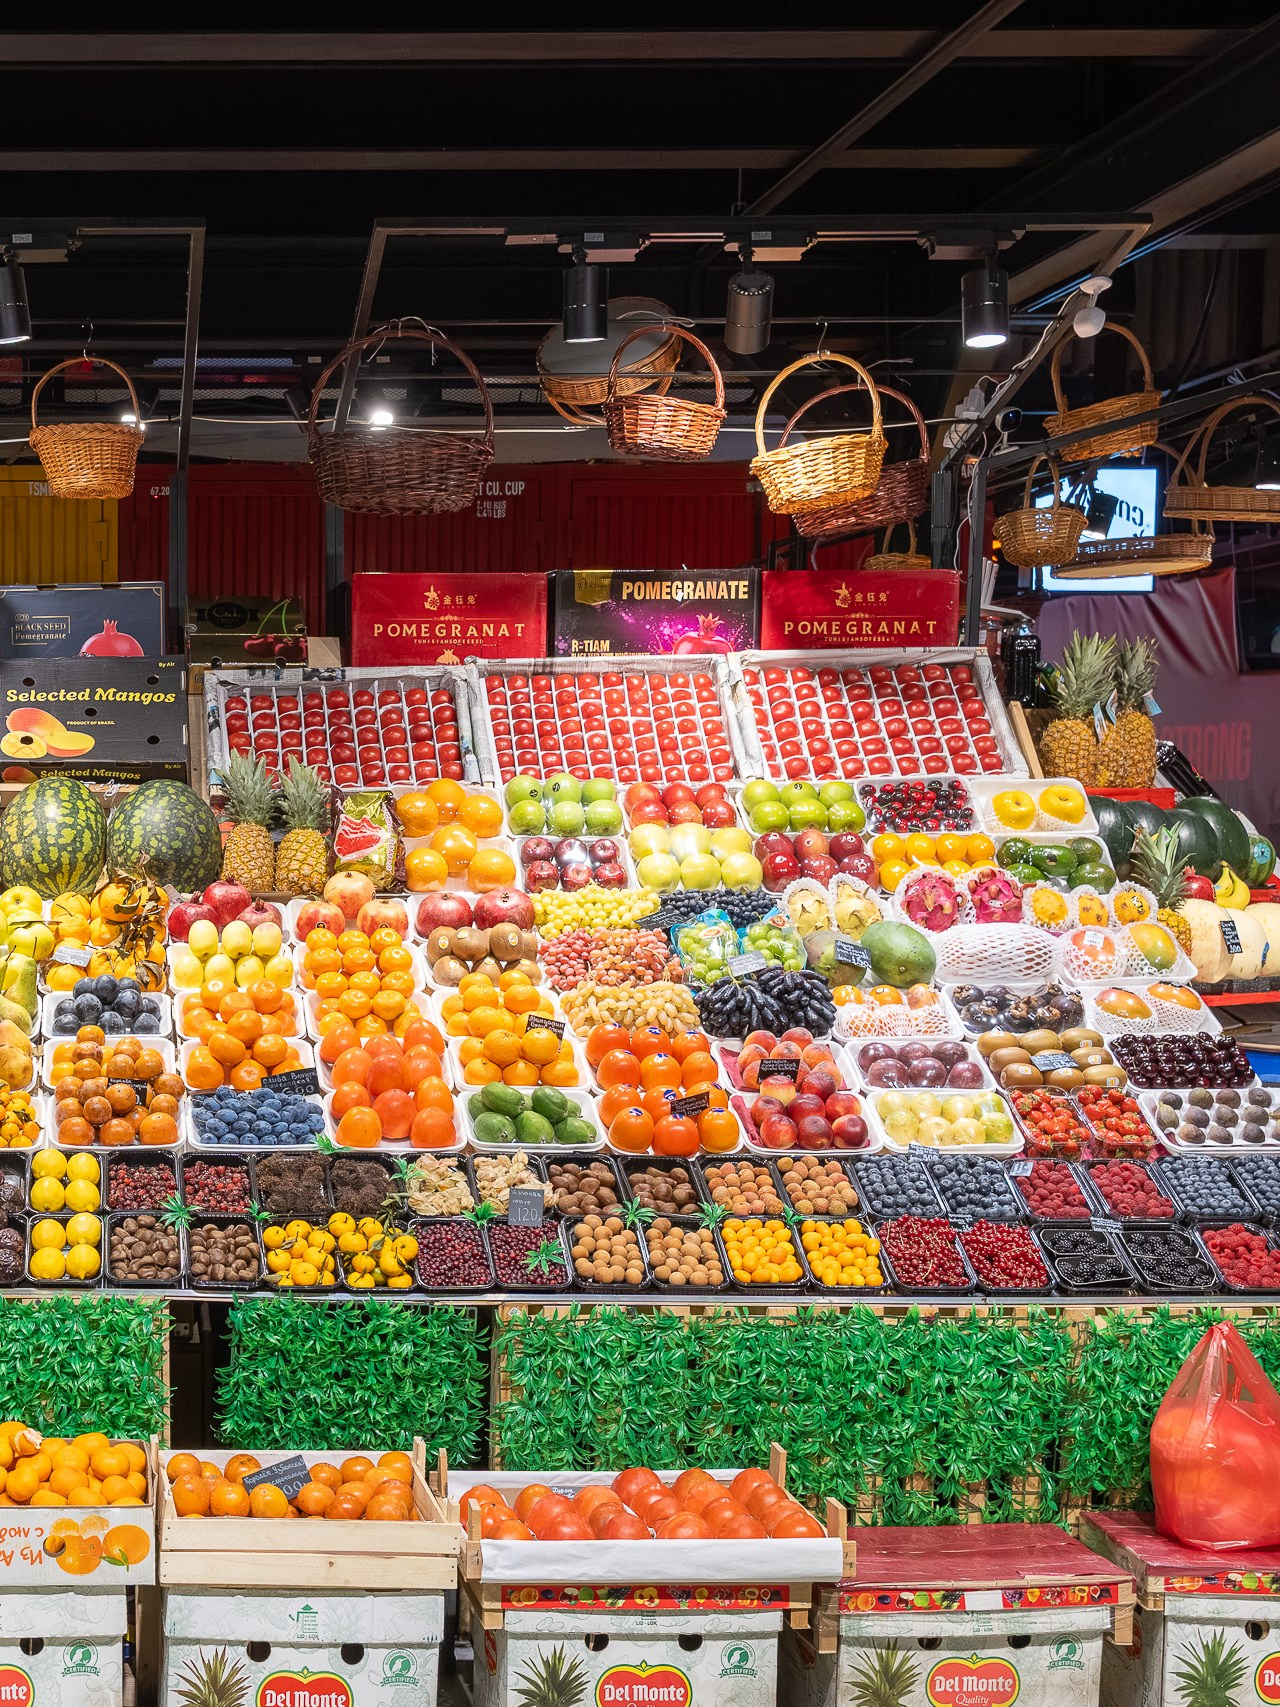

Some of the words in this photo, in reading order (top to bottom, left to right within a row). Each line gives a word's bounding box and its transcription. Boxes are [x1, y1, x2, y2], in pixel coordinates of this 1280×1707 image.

[486, 482, 503, 496] CU.
[505, 482, 525, 496] CUP
[622, 580, 749, 600] POMEGRANATE
[15, 623, 43, 631] BLACK
[44, 623, 66, 631] SEED
[373, 624, 525, 637] POMEGRANAT
[784, 621, 937, 635] POMEGRANAT
[15, 632, 67, 641] Pomegranate
[6, 688, 90, 703] Selected
[94, 687, 176, 705] Mangos
[1162, 720, 1251, 782] TRONG
[40, 769, 90, 778] Selected
[92, 768, 141, 780] Mangos
[23, 1548, 42, 1565] Из
[64, 1666, 96, 1674] CERTIFIED
[1050, 1660, 1080, 1668] CERTIFIED
[934, 1675, 960, 1692] Del
[962, 1675, 1013, 1692] Monte
[1263, 1670, 1280, 1687] De
[264, 1689, 292, 1707] Del
[293, 1689, 347, 1707] Monte
[603, 1684, 630, 1702] Del
[632, 1684, 685, 1702] Monte
[955, 1694, 989, 1706] Quality
